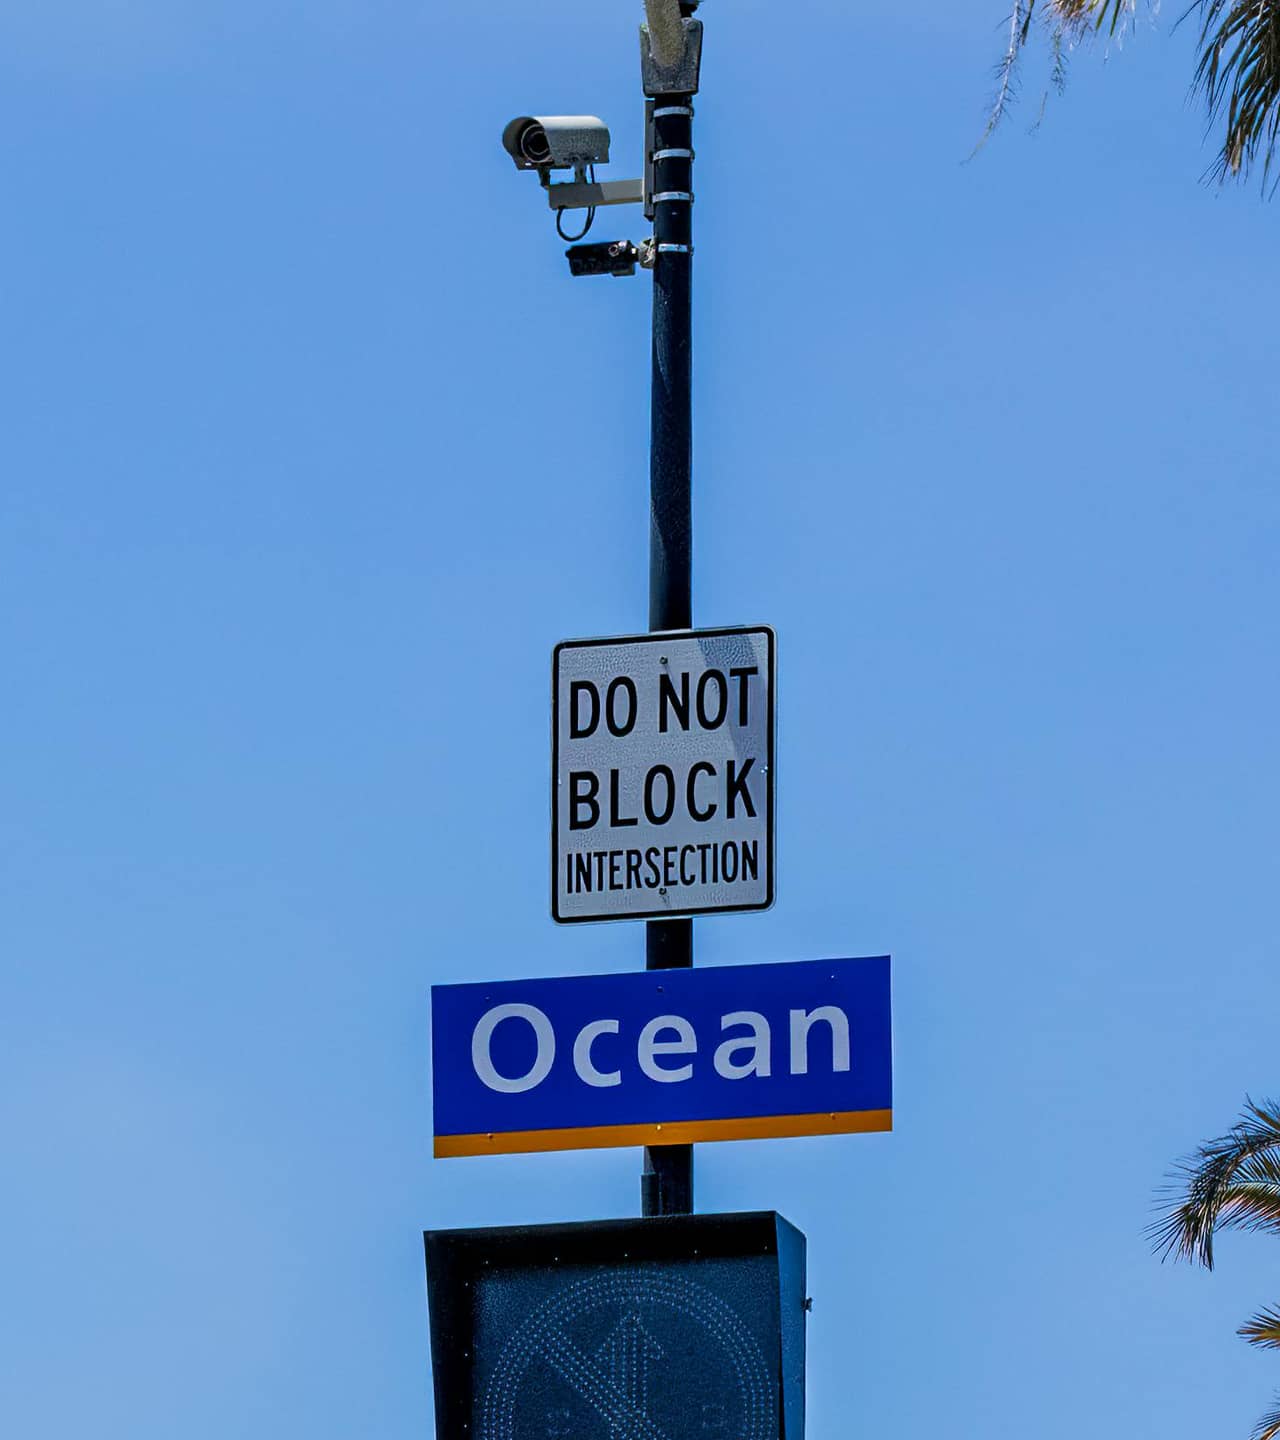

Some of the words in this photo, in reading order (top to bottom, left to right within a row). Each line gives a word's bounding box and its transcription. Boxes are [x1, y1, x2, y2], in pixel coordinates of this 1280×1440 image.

[568, 675, 638, 740] DO
[658, 666, 758, 734] NOT
[568, 758, 757, 831] BLOCK
[566, 840, 758, 894] INTERSECTION
[471, 1001, 851, 1094] Ocean
